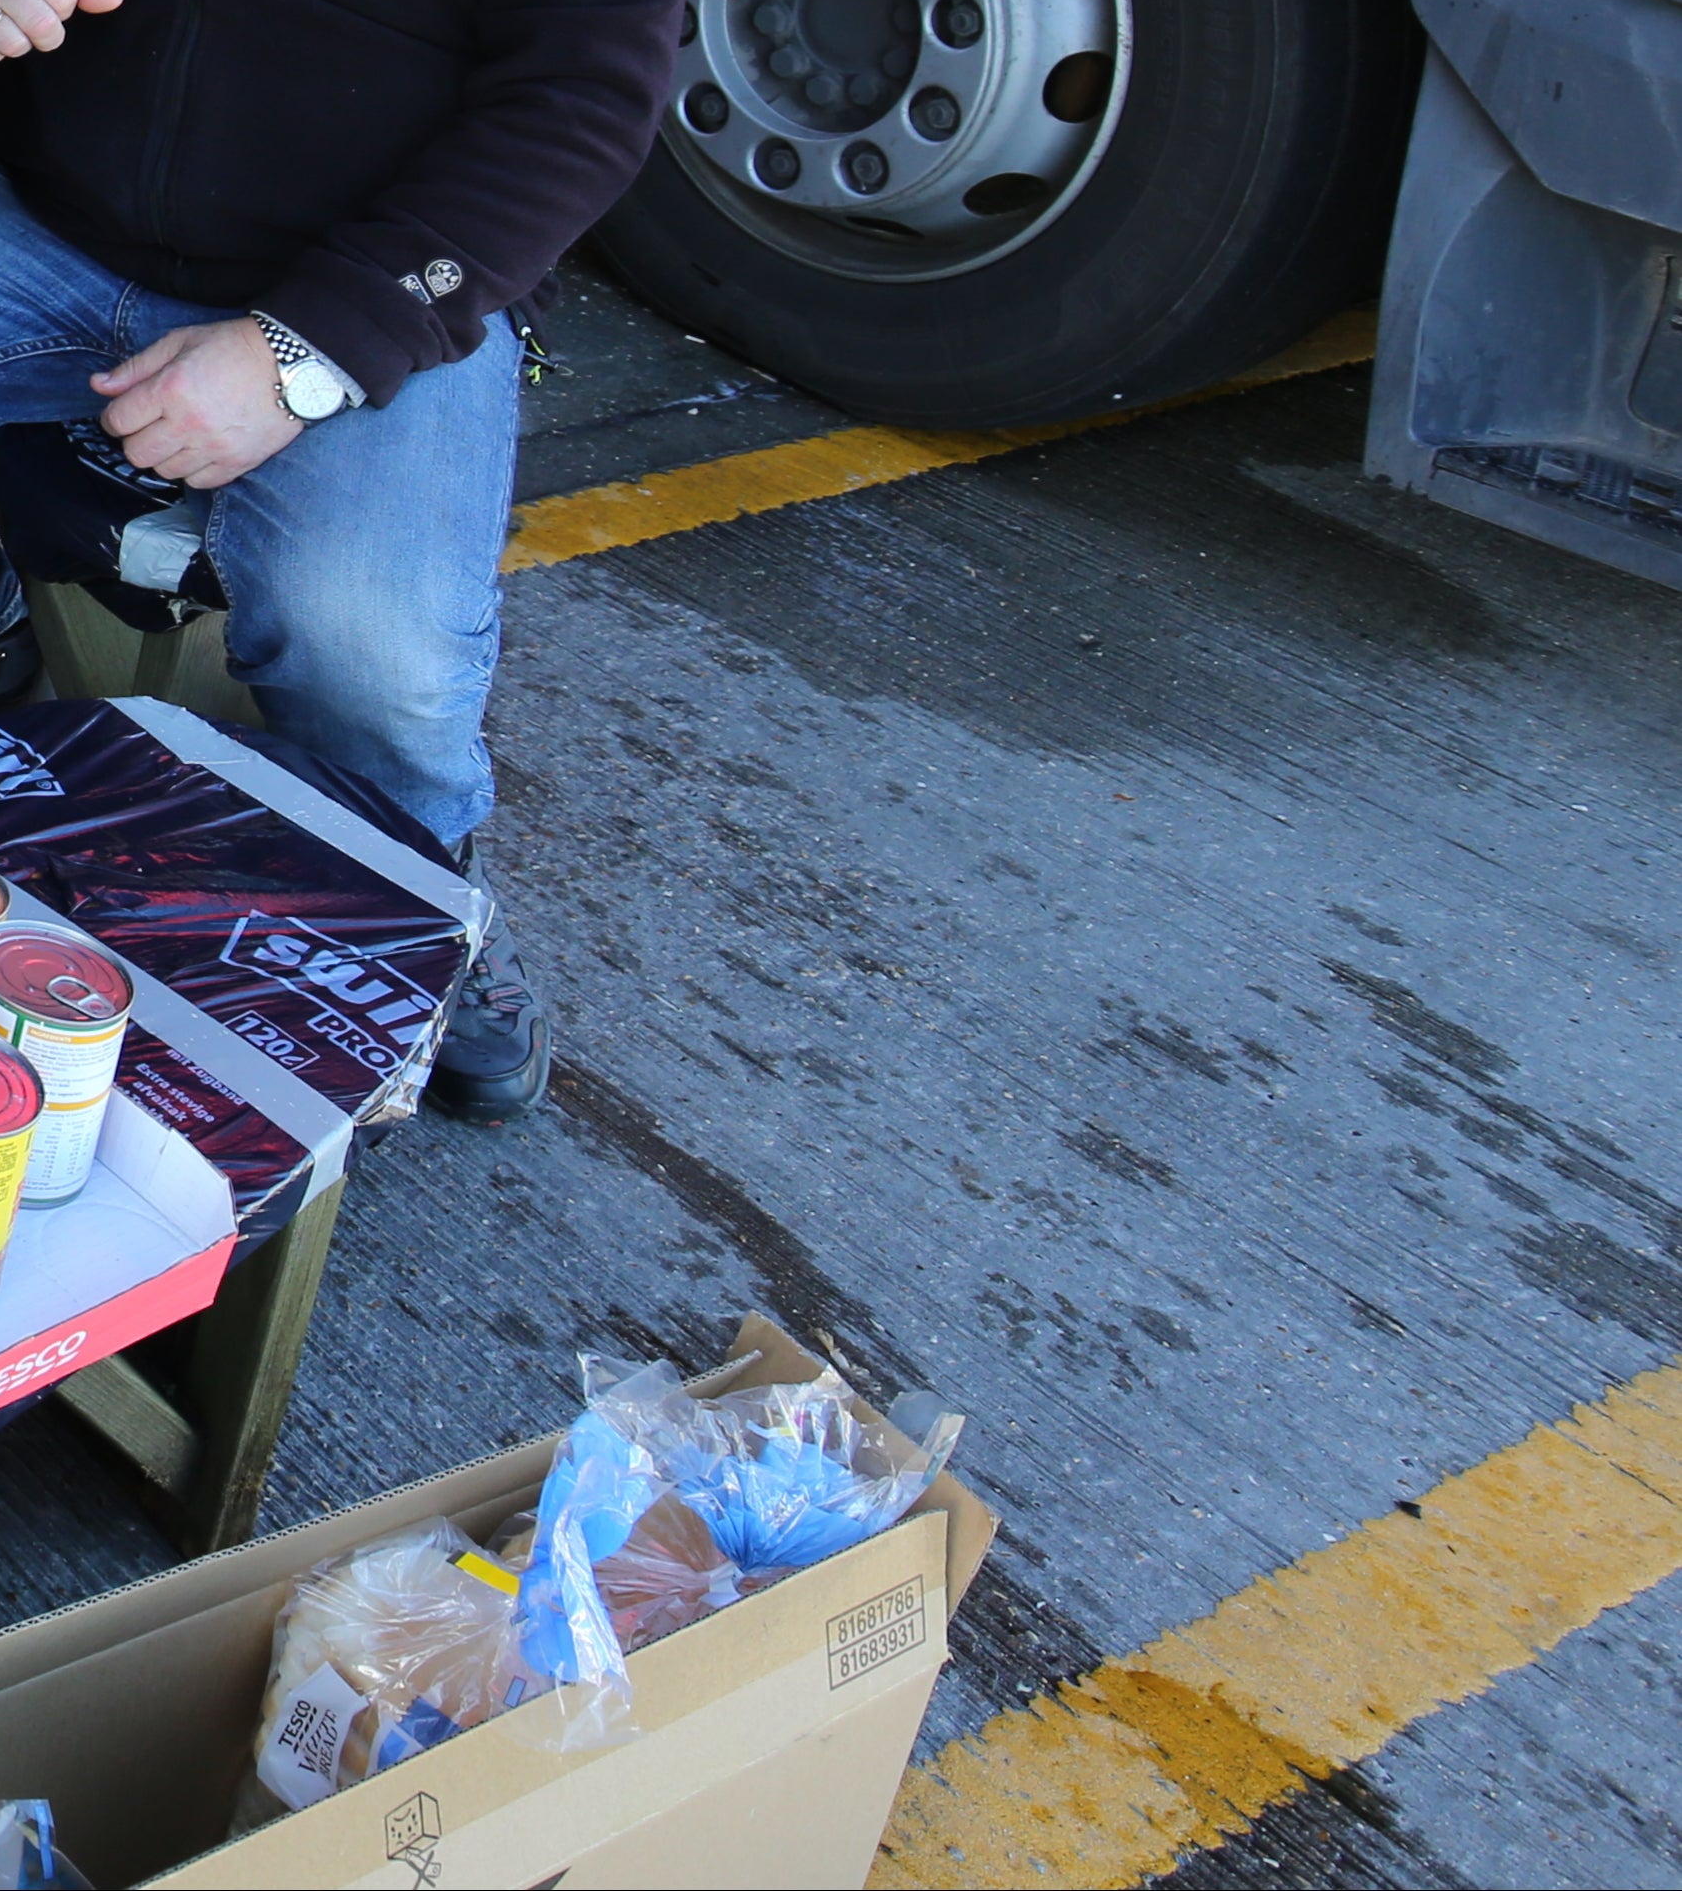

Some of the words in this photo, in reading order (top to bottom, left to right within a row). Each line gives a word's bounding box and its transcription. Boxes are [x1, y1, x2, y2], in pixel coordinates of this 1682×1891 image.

[29, 1028, 72, 1043] INGREDIENTS
[132, 1080, 188, 1122] afvalzak
[135, 1062, 171, 1089] Extra
[168, 1088, 215, 1123] stevige
[837, 1586, 914, 1644] 81681786
[840, 1618, 915, 1678] 81683931
[278, 1700, 312, 1748] TESCO
